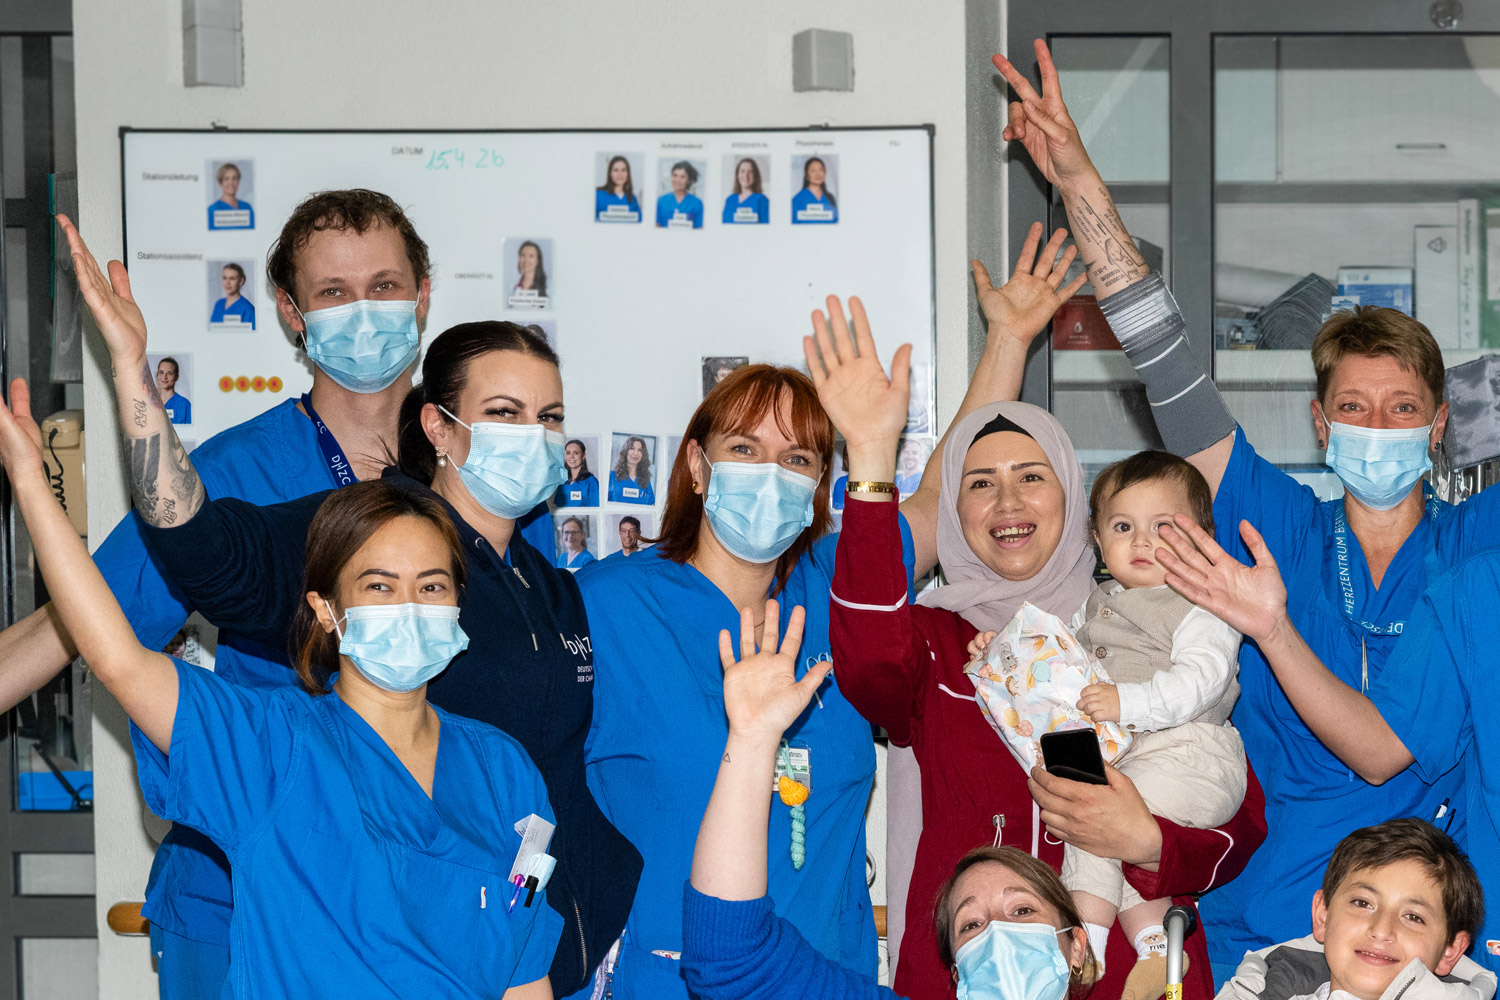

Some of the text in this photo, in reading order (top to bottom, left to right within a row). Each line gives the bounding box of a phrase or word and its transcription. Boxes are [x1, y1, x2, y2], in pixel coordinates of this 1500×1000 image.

[391, 147, 423, 155] DATUM
[1335, 536, 1354, 615] HERZZENTRUM
[1149, 943, 1166, 951] me
